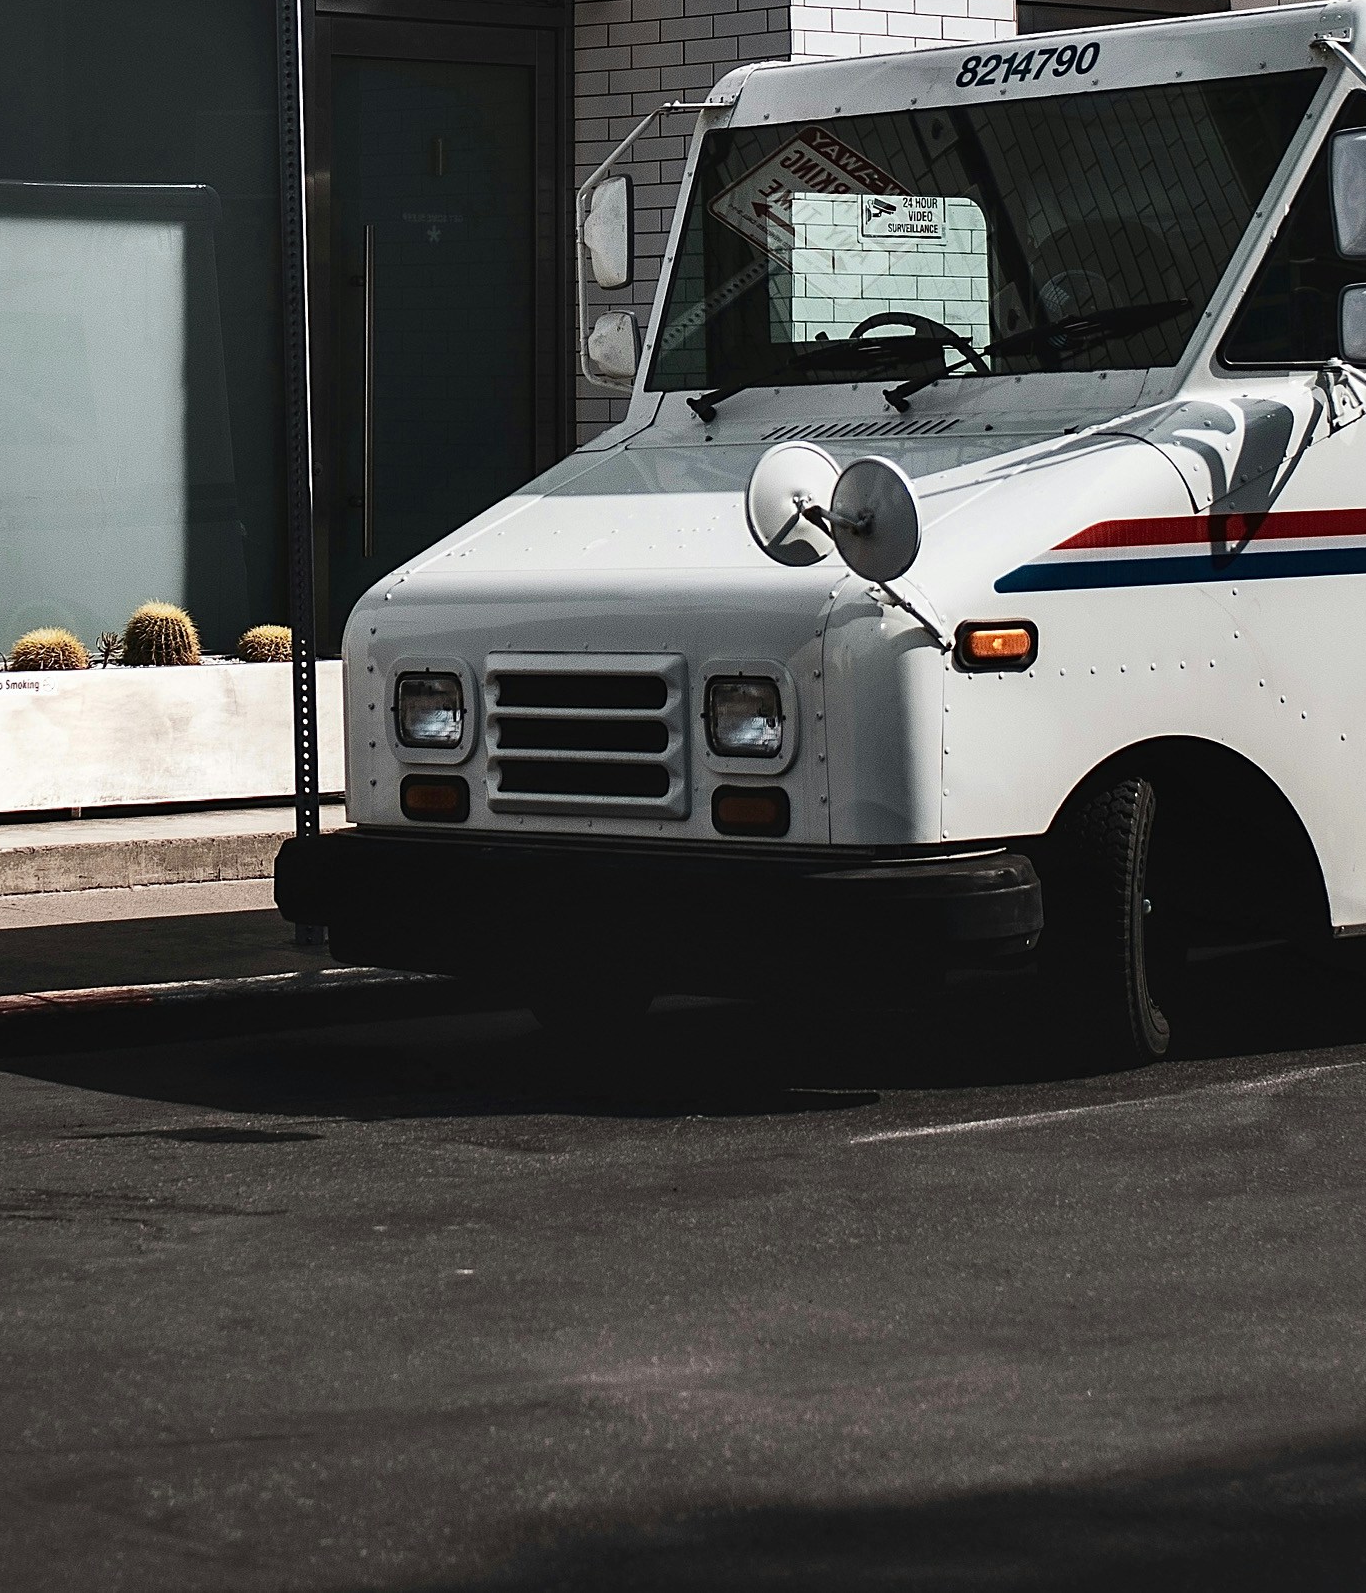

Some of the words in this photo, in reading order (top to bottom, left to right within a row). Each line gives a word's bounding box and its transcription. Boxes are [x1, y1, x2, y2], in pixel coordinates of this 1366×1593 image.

[955, 42, 1101, 88] 8214790
[902, 197, 913, 208] 24
[915, 198, 938, 209] HOUR
[908, 211, 933, 222] VIDEO
[887, 223, 938, 234] SURVEILLANCE
[5, 678, 40, 692] Smoking
